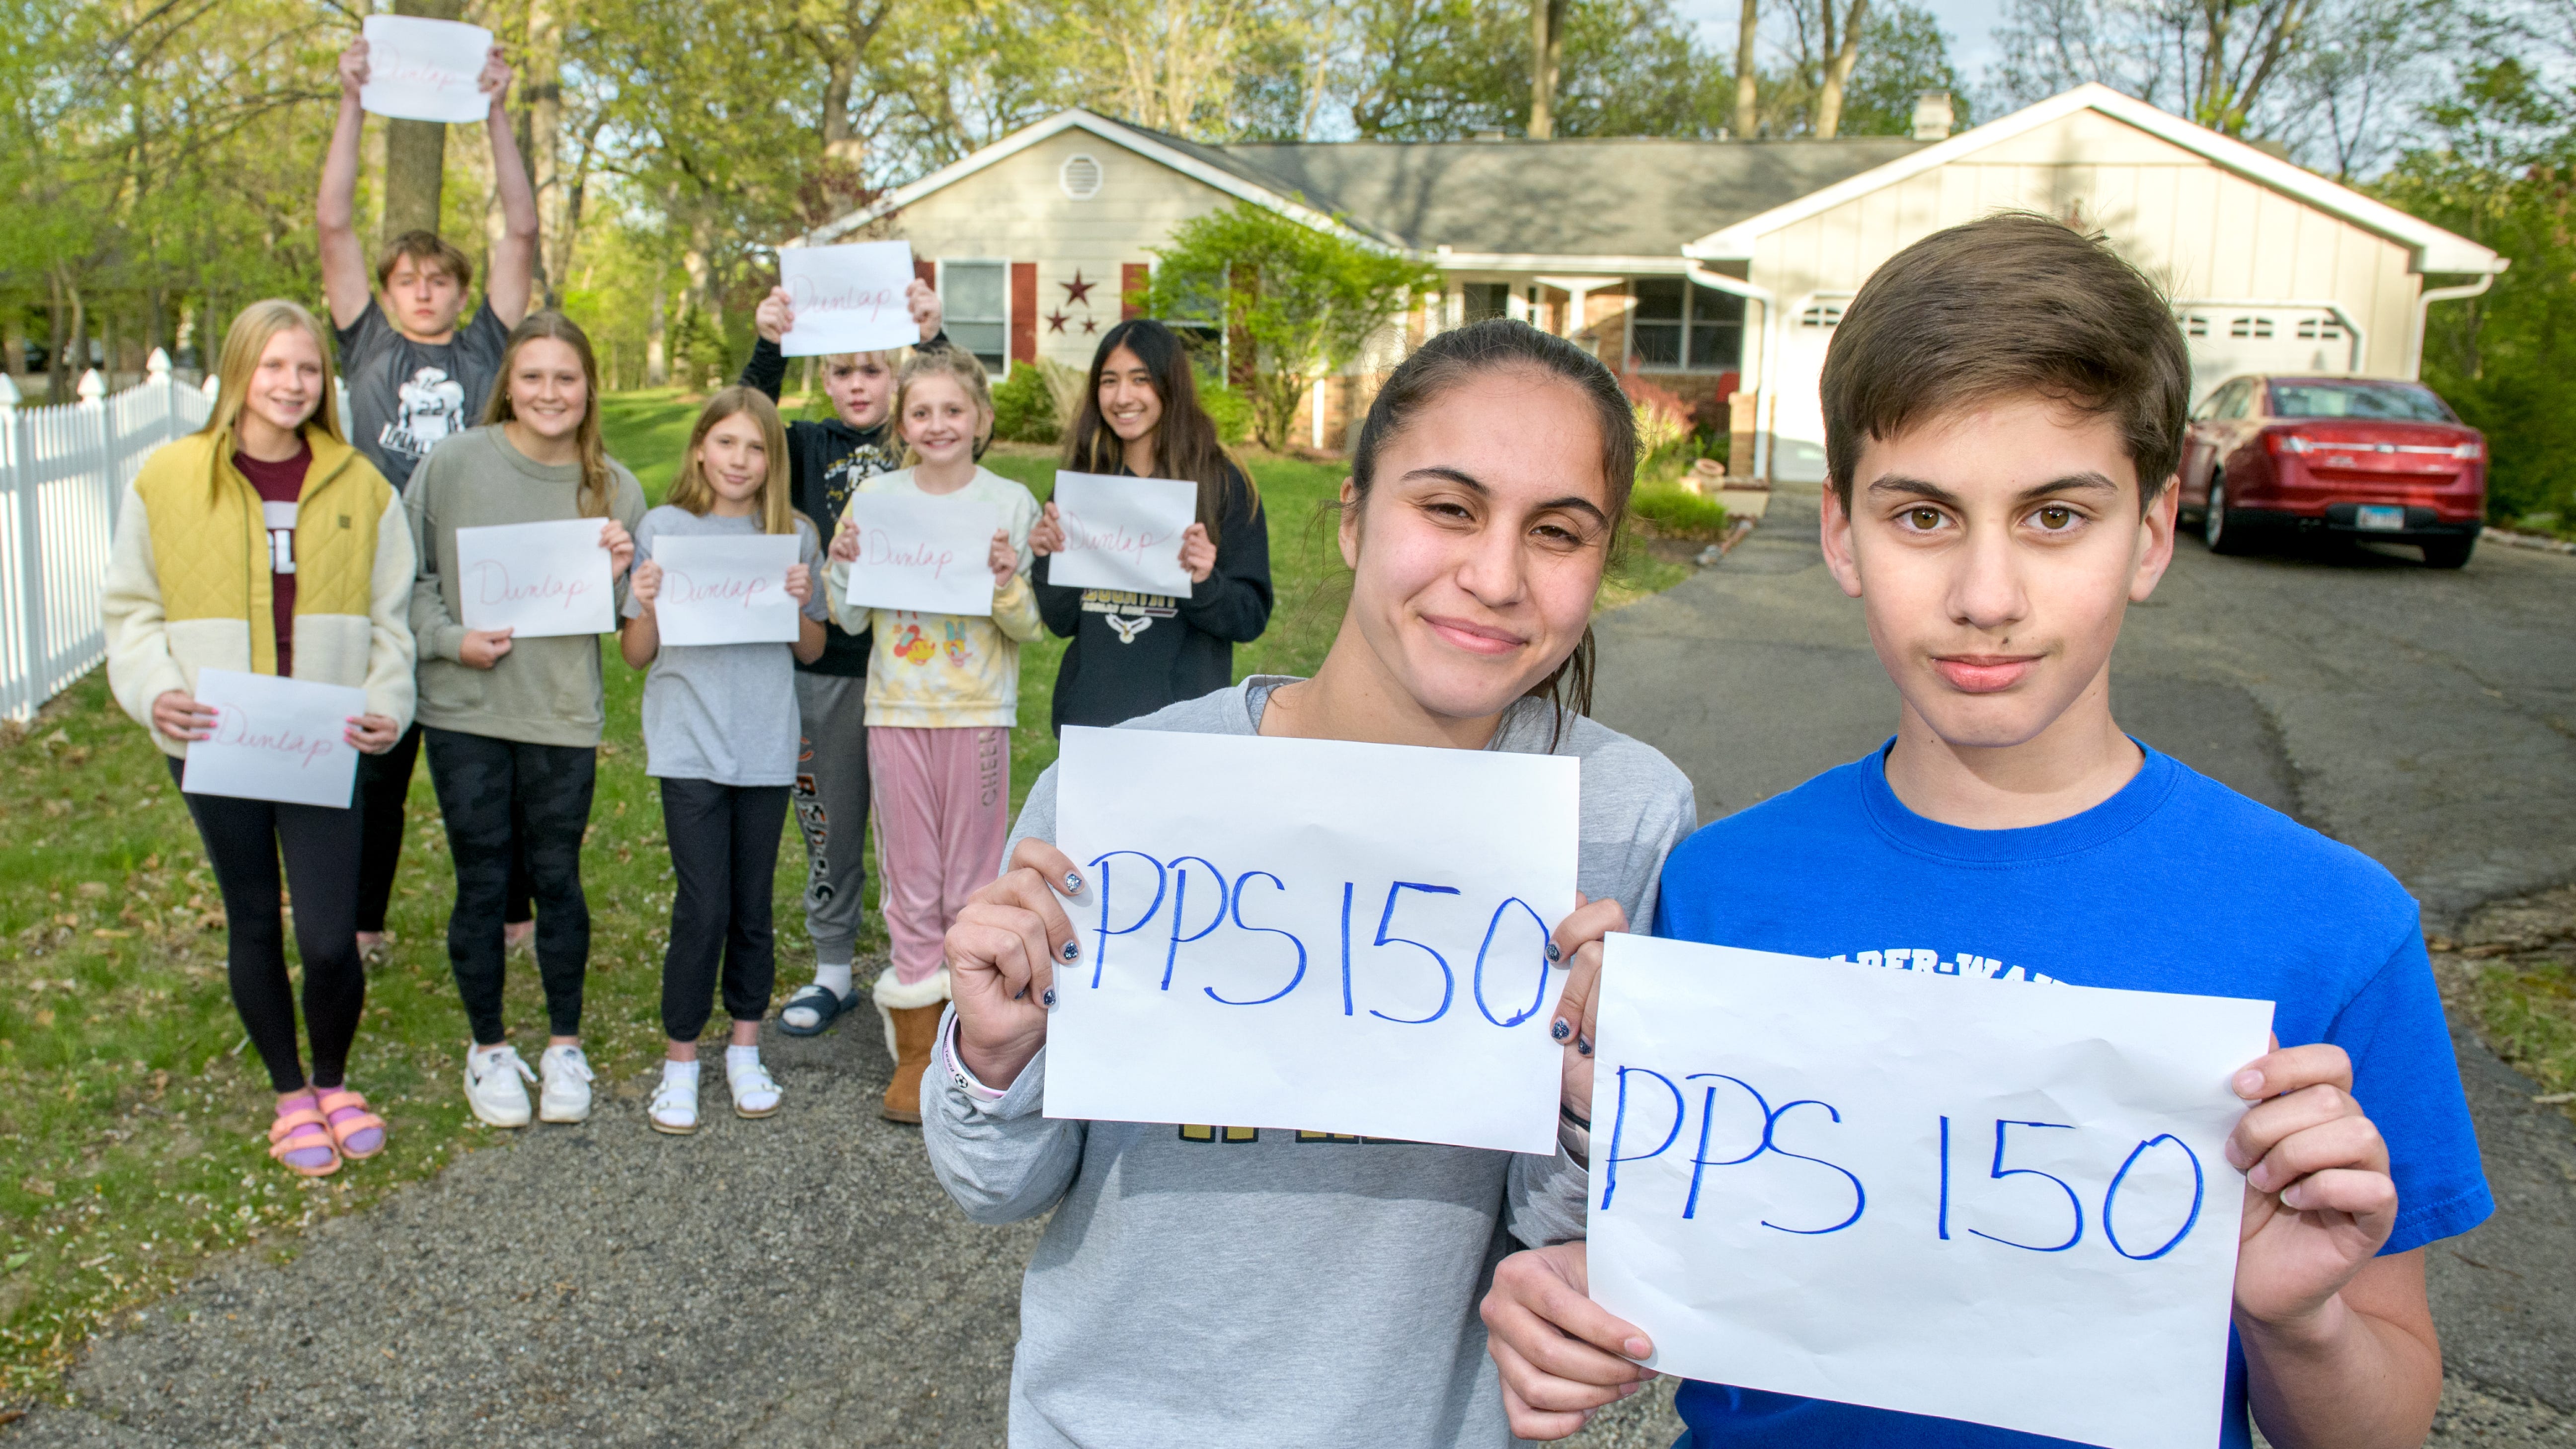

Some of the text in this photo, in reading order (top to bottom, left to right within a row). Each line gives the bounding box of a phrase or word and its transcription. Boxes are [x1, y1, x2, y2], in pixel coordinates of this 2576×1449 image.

[788, 273, 891, 323] Dunlap
[869, 528, 954, 580] Dunlap
[1067, 510, 1175, 565] Dunlap
[473, 558, 593, 610] Dunlap
[664, 569, 770, 609] Dunlap
[216, 702, 334, 768] Dunlap
[1088, 851, 1550, 1027] PPS 150
[1601, 1066, 2204, 1261] PPS 150
